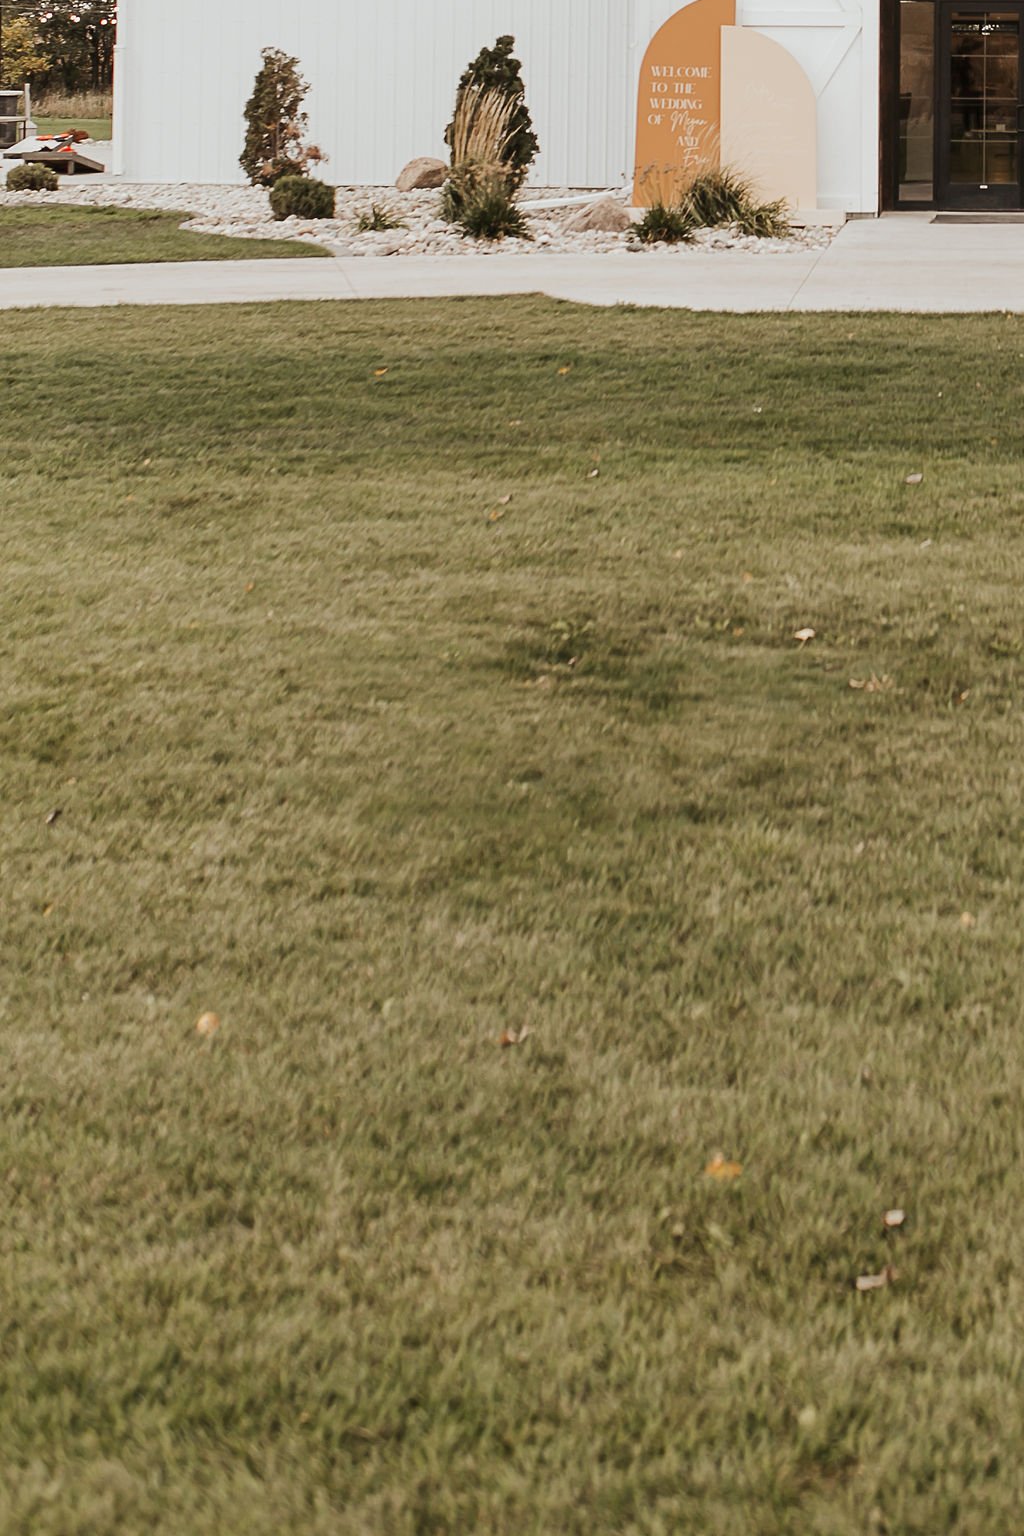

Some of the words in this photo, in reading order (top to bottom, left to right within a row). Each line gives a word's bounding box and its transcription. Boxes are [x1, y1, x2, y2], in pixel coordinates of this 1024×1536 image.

[651, 66, 712, 78] WELCOME
[651, 82, 668, 93] TO
[673, 82, 696, 94] THE
[649, 98, 702, 110] WEDDING
[648, 113, 665, 125] OF
[677, 135, 700, 146] AND
